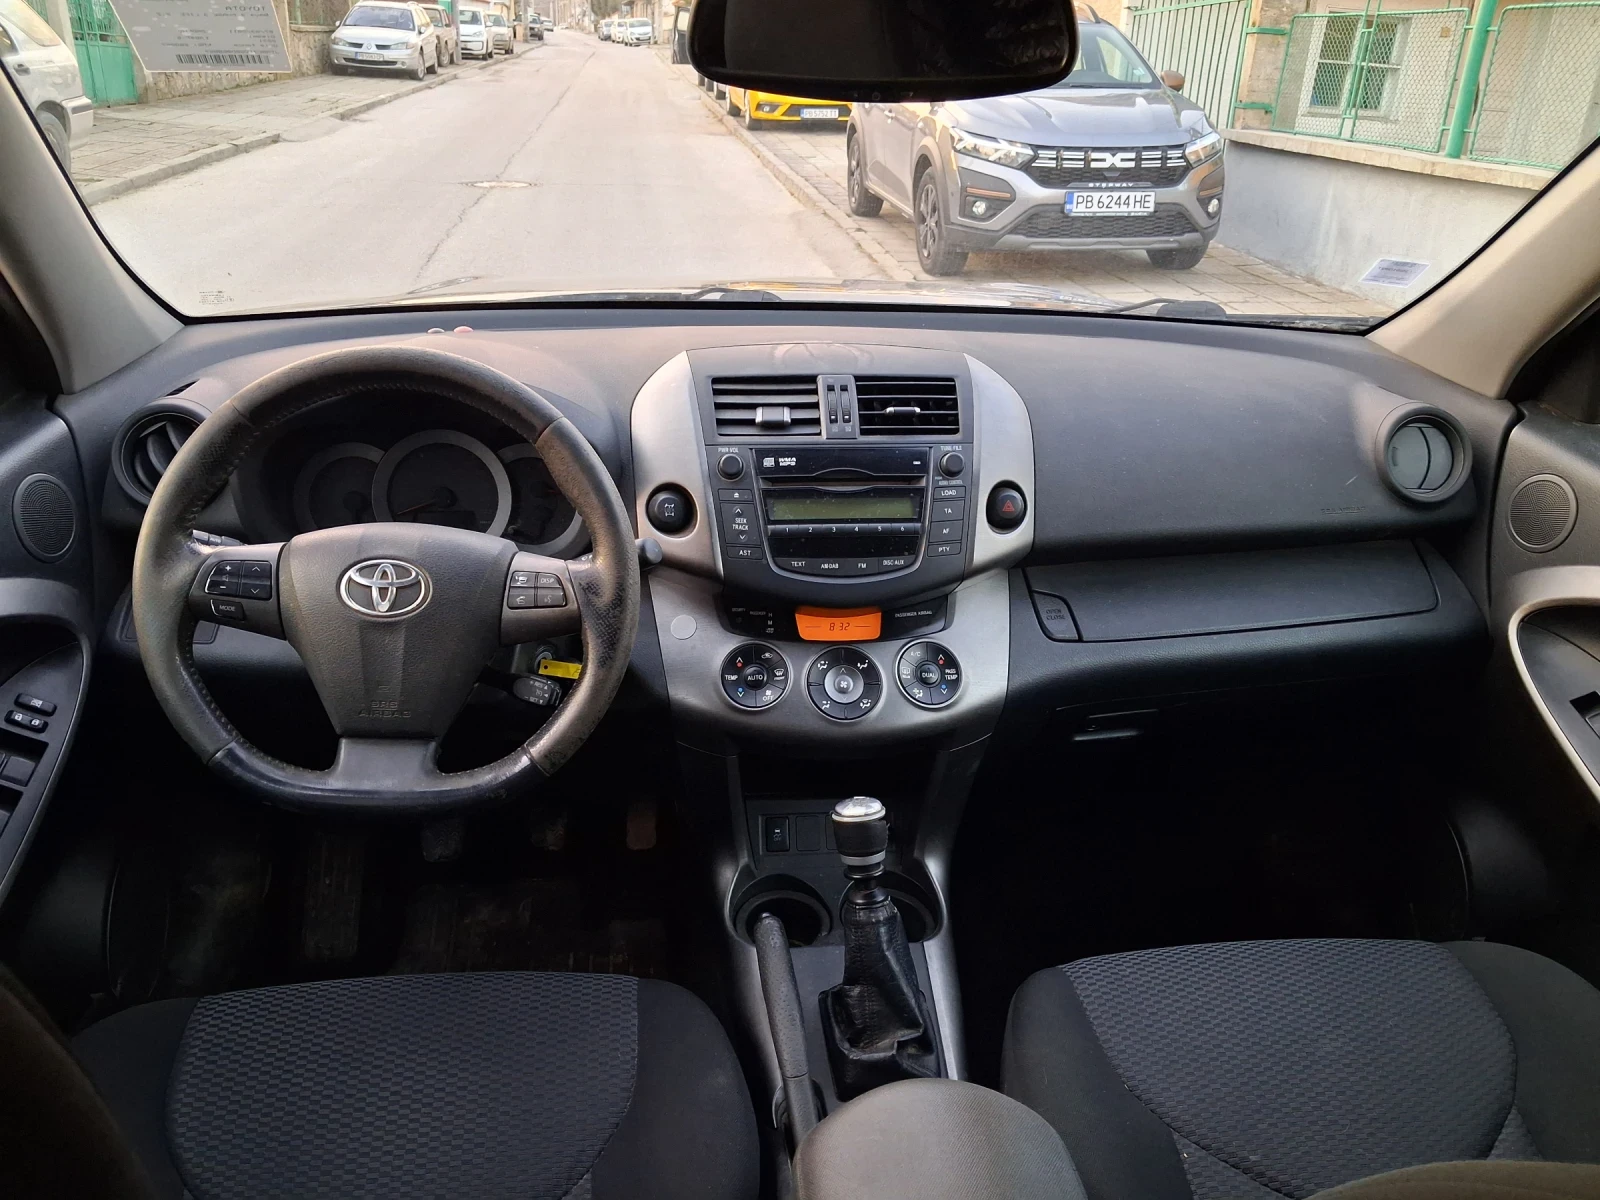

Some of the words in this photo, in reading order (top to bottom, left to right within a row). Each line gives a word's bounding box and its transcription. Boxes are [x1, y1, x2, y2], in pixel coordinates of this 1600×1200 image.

[1076, 194, 1094, 210] PB
[1097, 194, 1131, 209] 6244
[1133, 194, 1152, 209] HE
